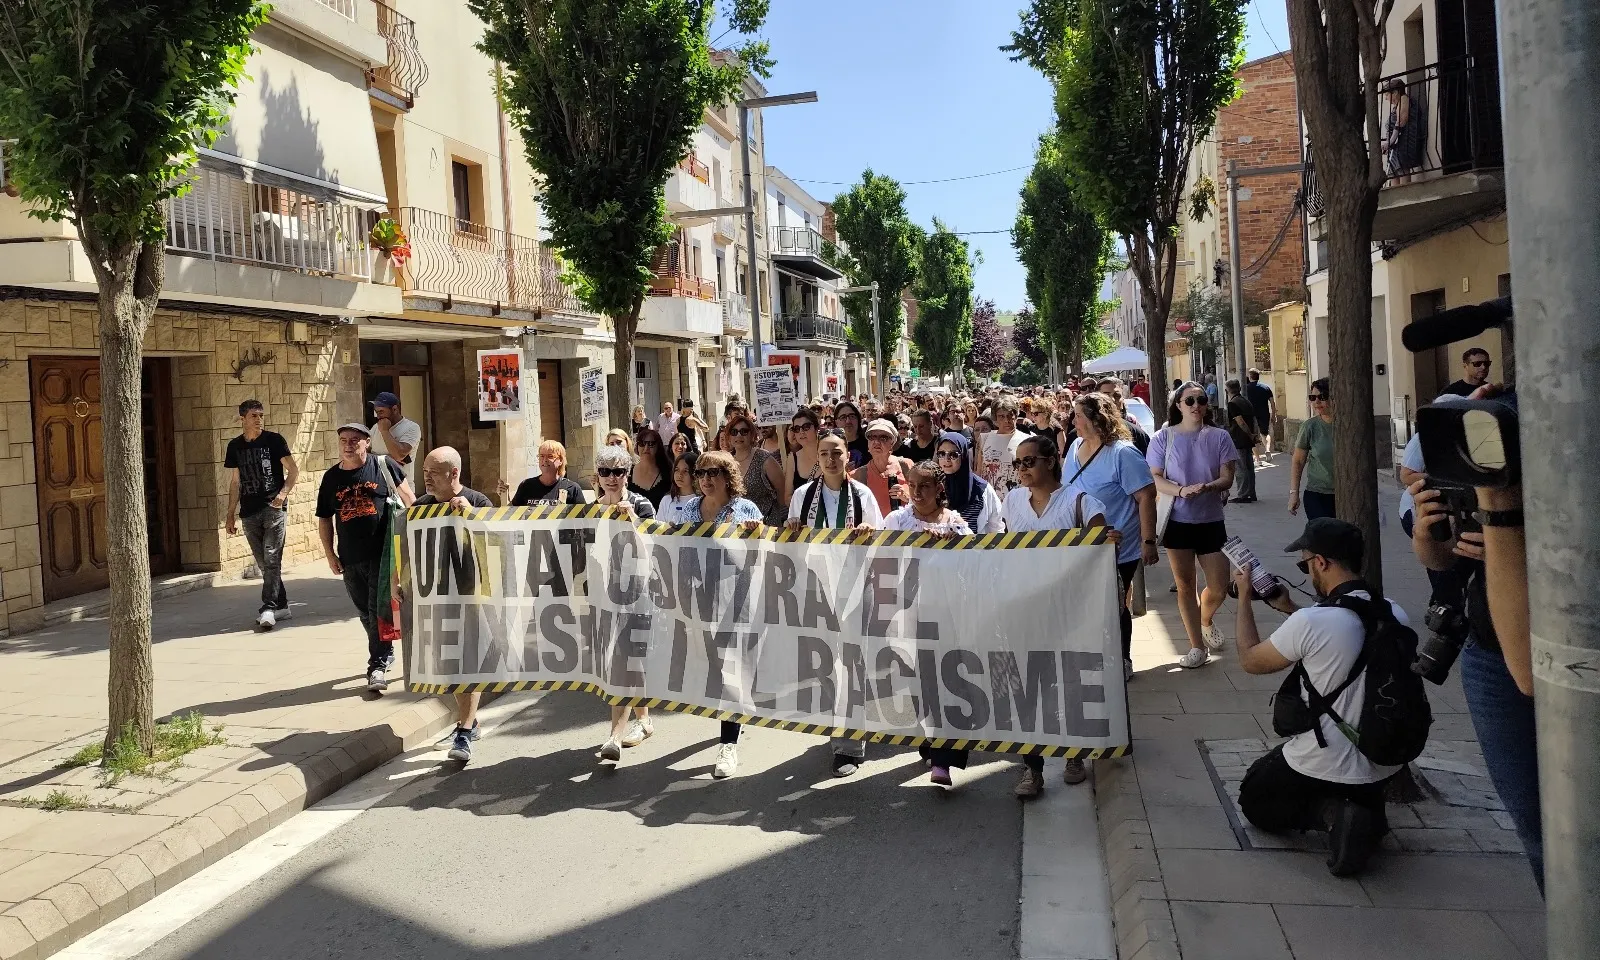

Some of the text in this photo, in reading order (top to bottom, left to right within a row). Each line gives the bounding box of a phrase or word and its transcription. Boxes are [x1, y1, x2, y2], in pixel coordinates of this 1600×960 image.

[414, 526, 940, 640] UNITAT CONTRA EL
[417, 603, 1111, 738] FEIXISME I EL RACISME
